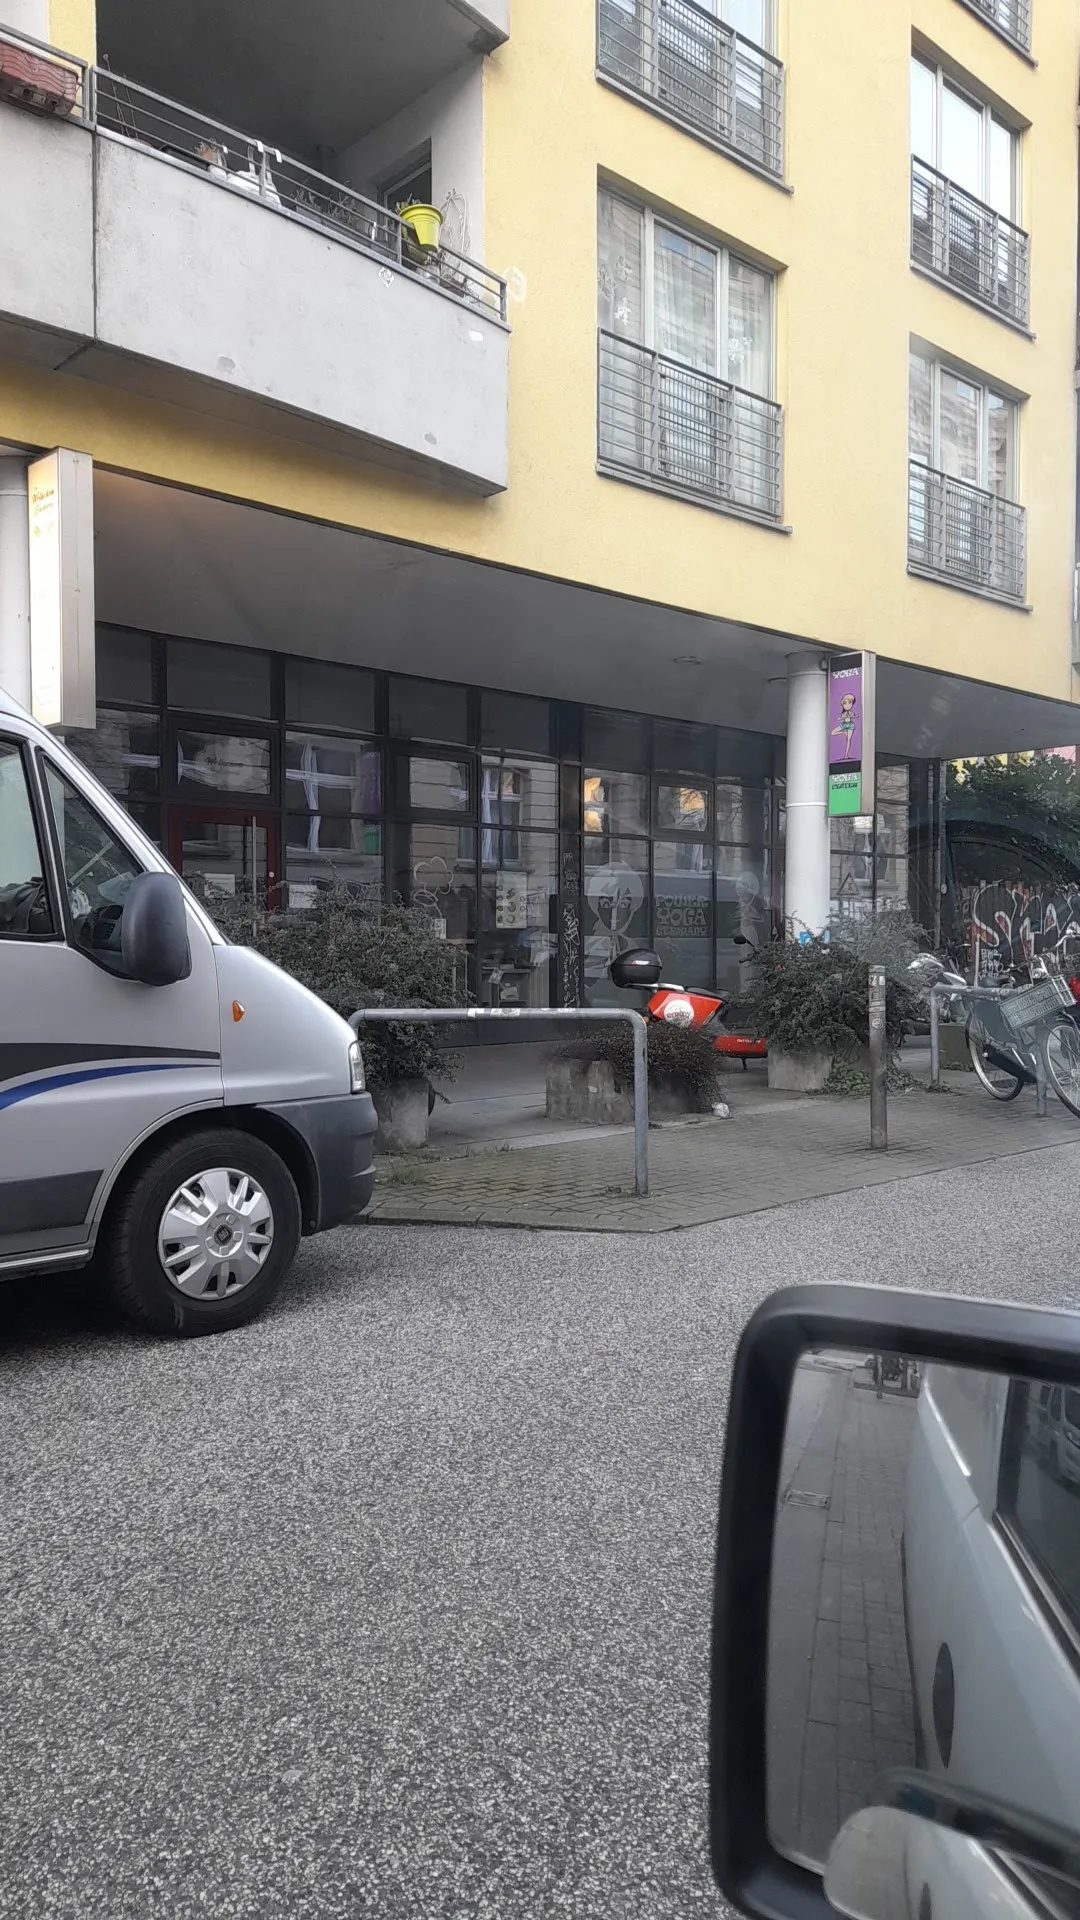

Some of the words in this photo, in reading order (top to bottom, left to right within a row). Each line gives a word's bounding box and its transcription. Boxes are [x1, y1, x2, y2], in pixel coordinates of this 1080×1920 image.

[832, 668, 859, 679] YOGA
[831, 772, 858, 782] YOGA
[655, 907, 707, 926] YOGA
